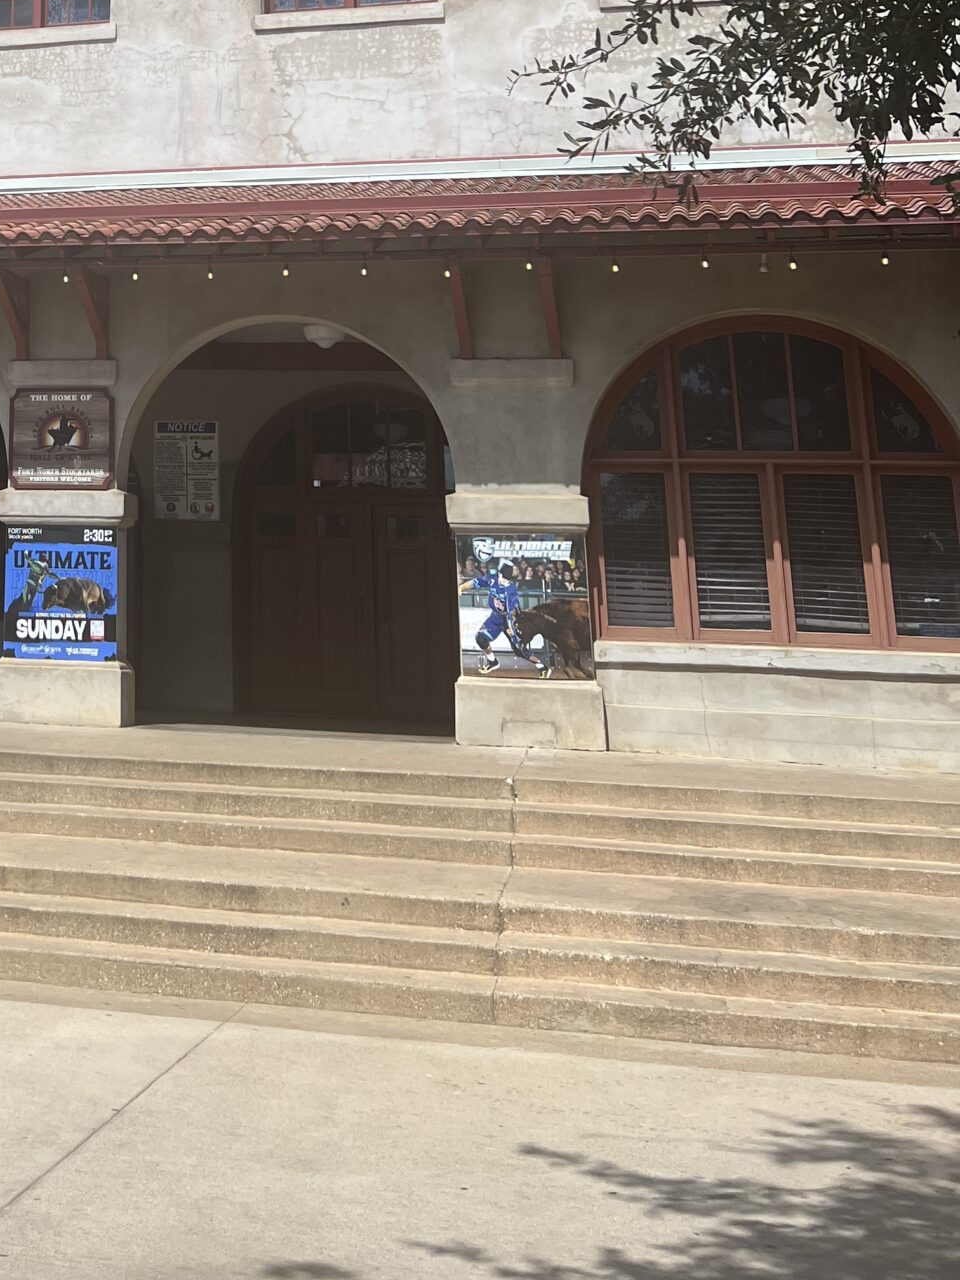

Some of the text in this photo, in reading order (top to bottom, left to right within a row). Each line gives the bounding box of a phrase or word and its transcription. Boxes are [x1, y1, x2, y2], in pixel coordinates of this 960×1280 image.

[167, 422, 206, 432] NOTICE
[17, 466, 104, 476] FORT WORTH STOCKYARDS
[83, 529, 104, 542] 2:30
[494, 541, 572, 550] ULTIMATE
[16, 618, 87, 640] SUNDAY
